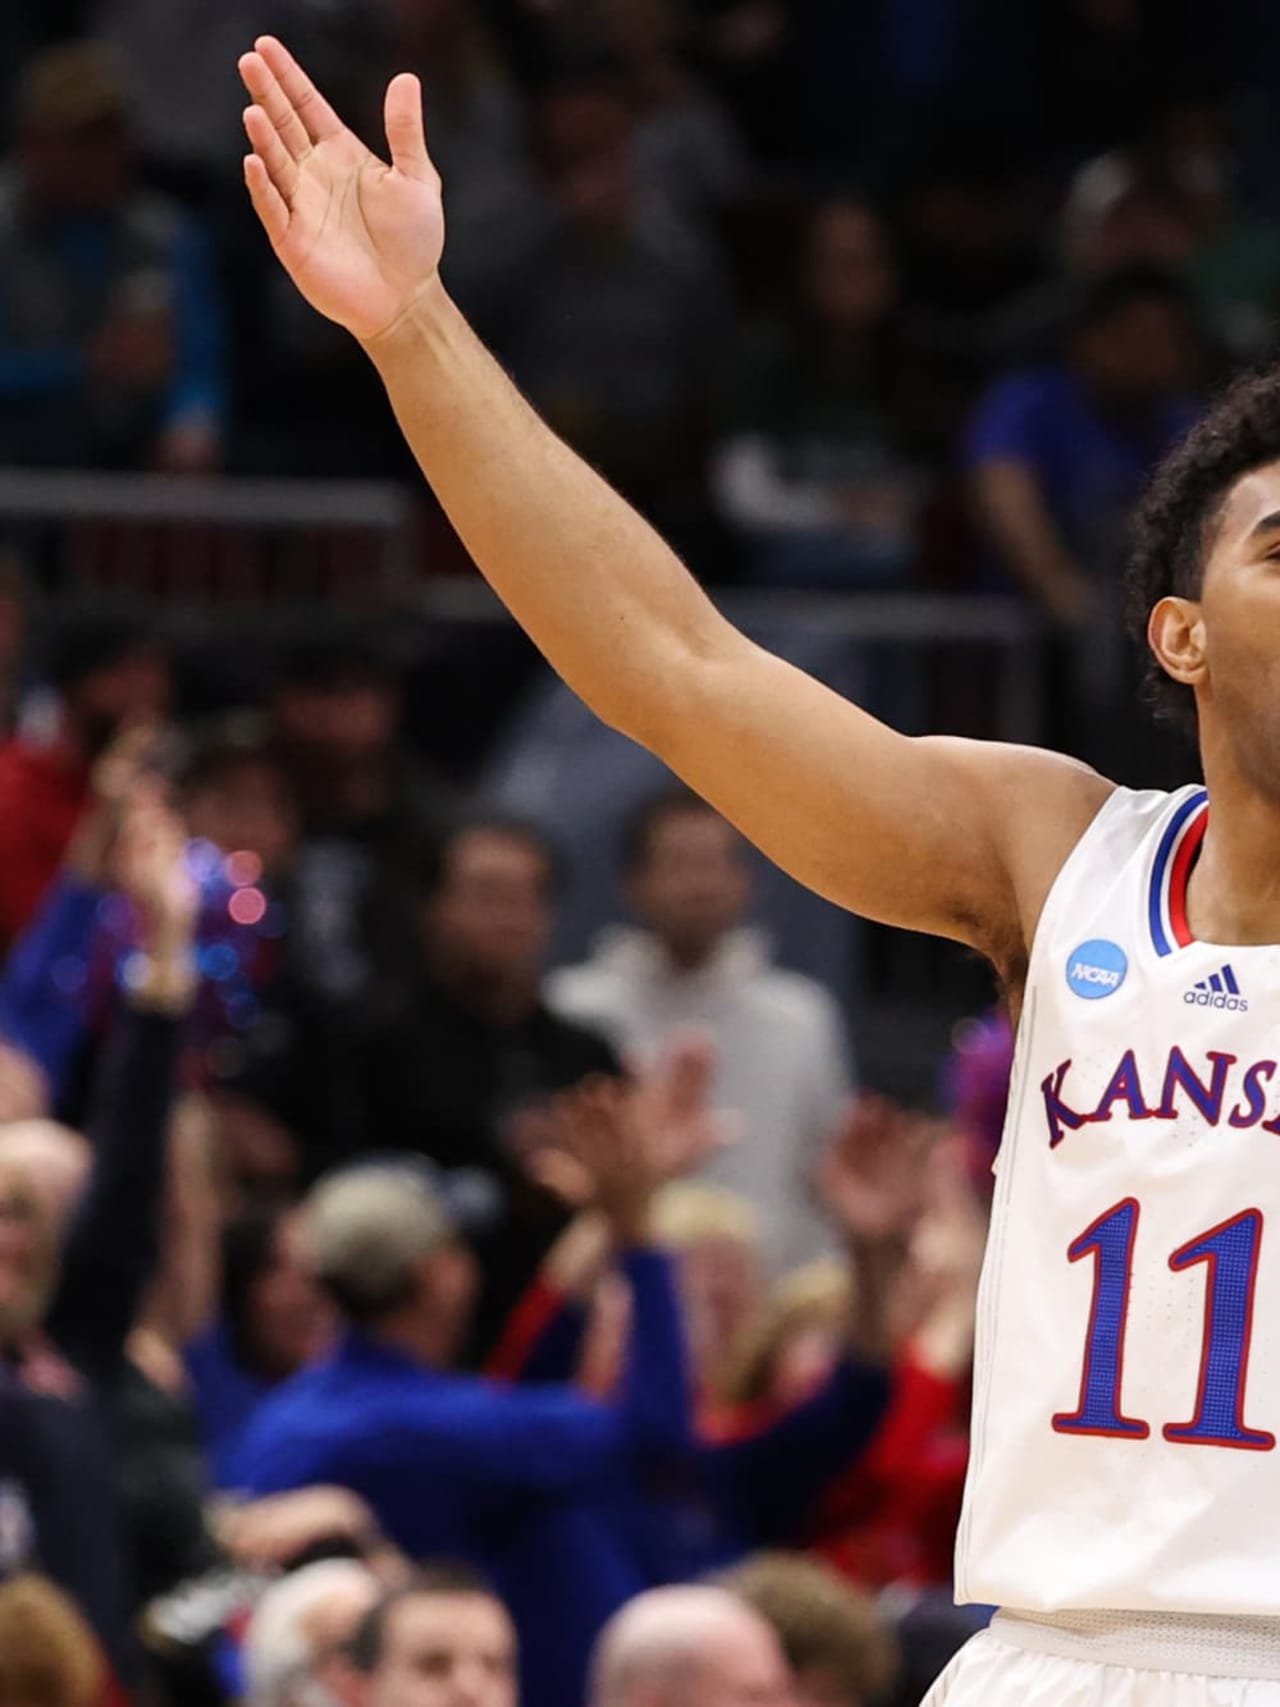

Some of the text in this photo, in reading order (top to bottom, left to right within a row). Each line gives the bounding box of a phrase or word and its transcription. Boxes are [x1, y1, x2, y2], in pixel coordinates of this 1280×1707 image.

[1072, 962, 1120, 986] NCAA
[1183, 990, 1248, 1012] adidas
[1051, 1196, 1276, 1451] 11
